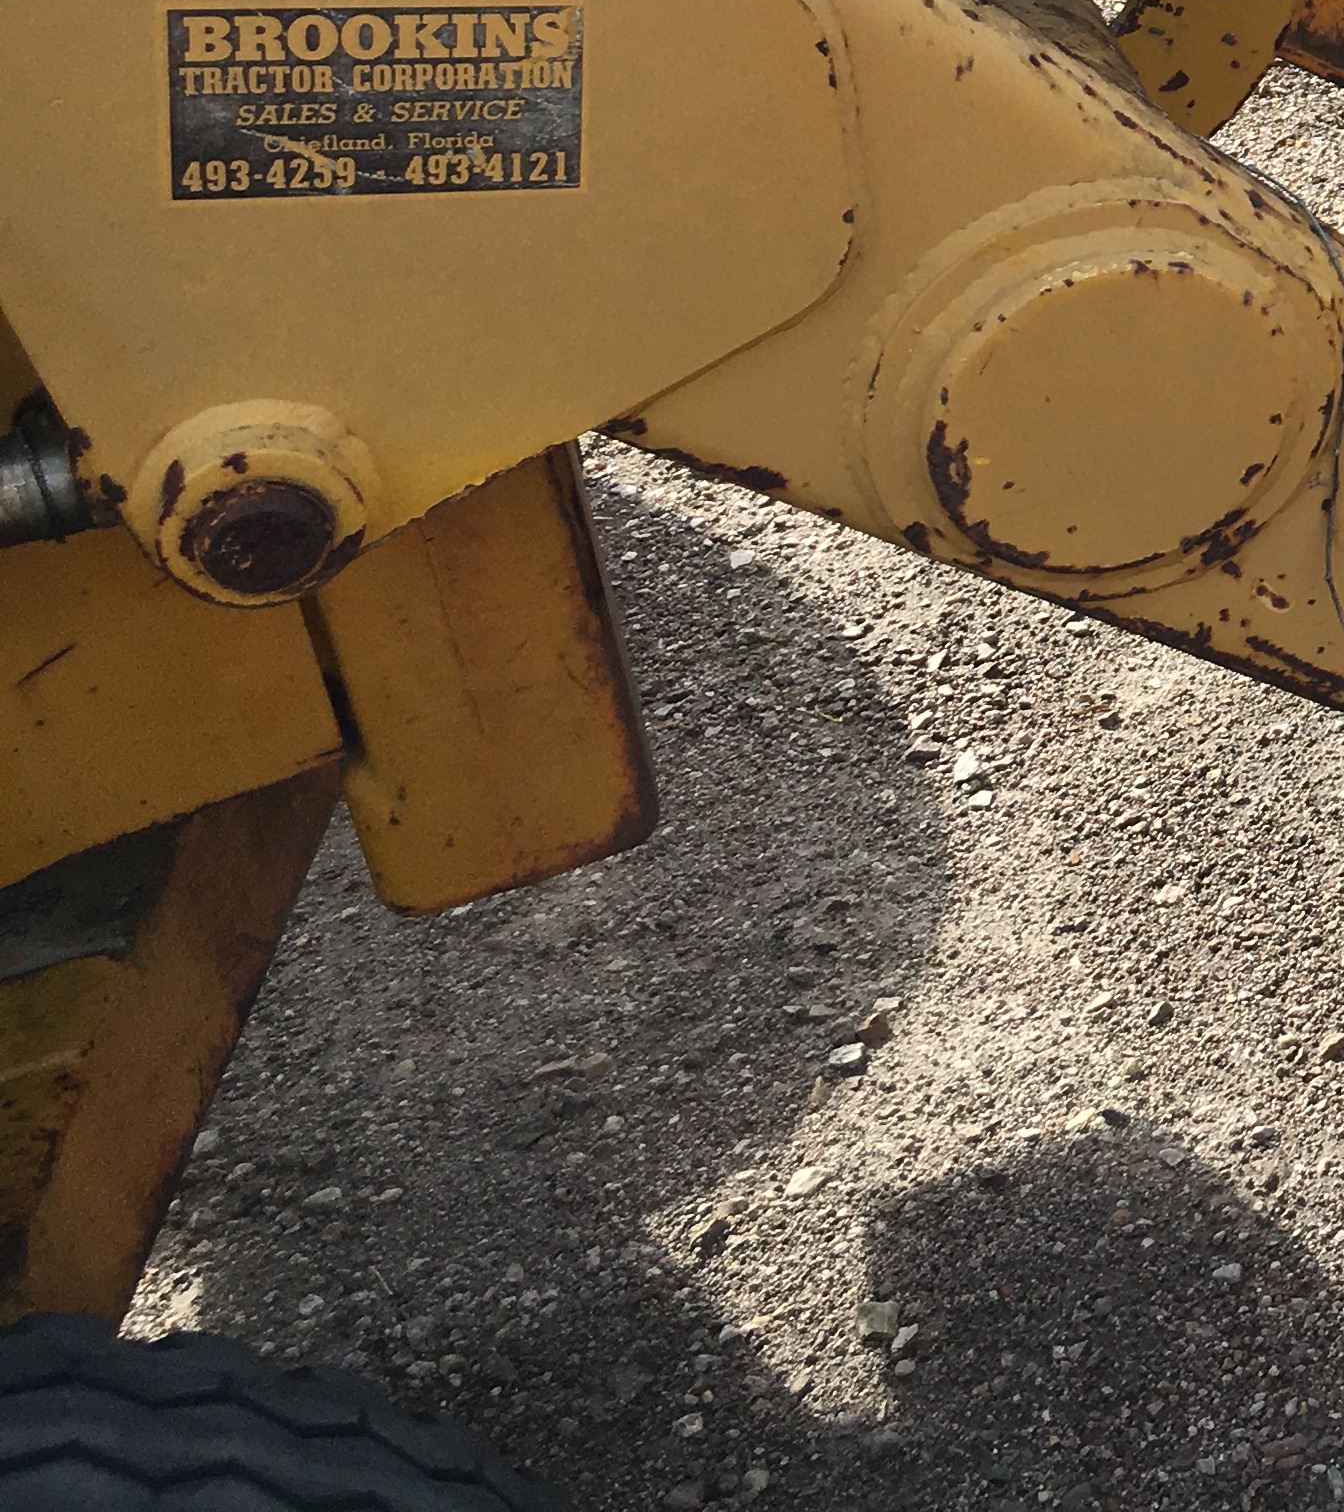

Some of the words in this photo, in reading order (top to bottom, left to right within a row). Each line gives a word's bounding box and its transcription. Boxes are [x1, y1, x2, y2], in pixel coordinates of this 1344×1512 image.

[183, 13, 570, 62] BROOKINS
[179, 65, 334, 95] TRACTOR
[353, 60, 574, 92] CORPORATION
[235, 103, 338, 126] SALES
[353, 102, 376, 123] &
[391, 100, 526, 123] SERVICE
[407, 131, 494, 149] Florida
[182, 156, 356, 192] 493-4259
[404, 151, 568, 185] 493-4121
